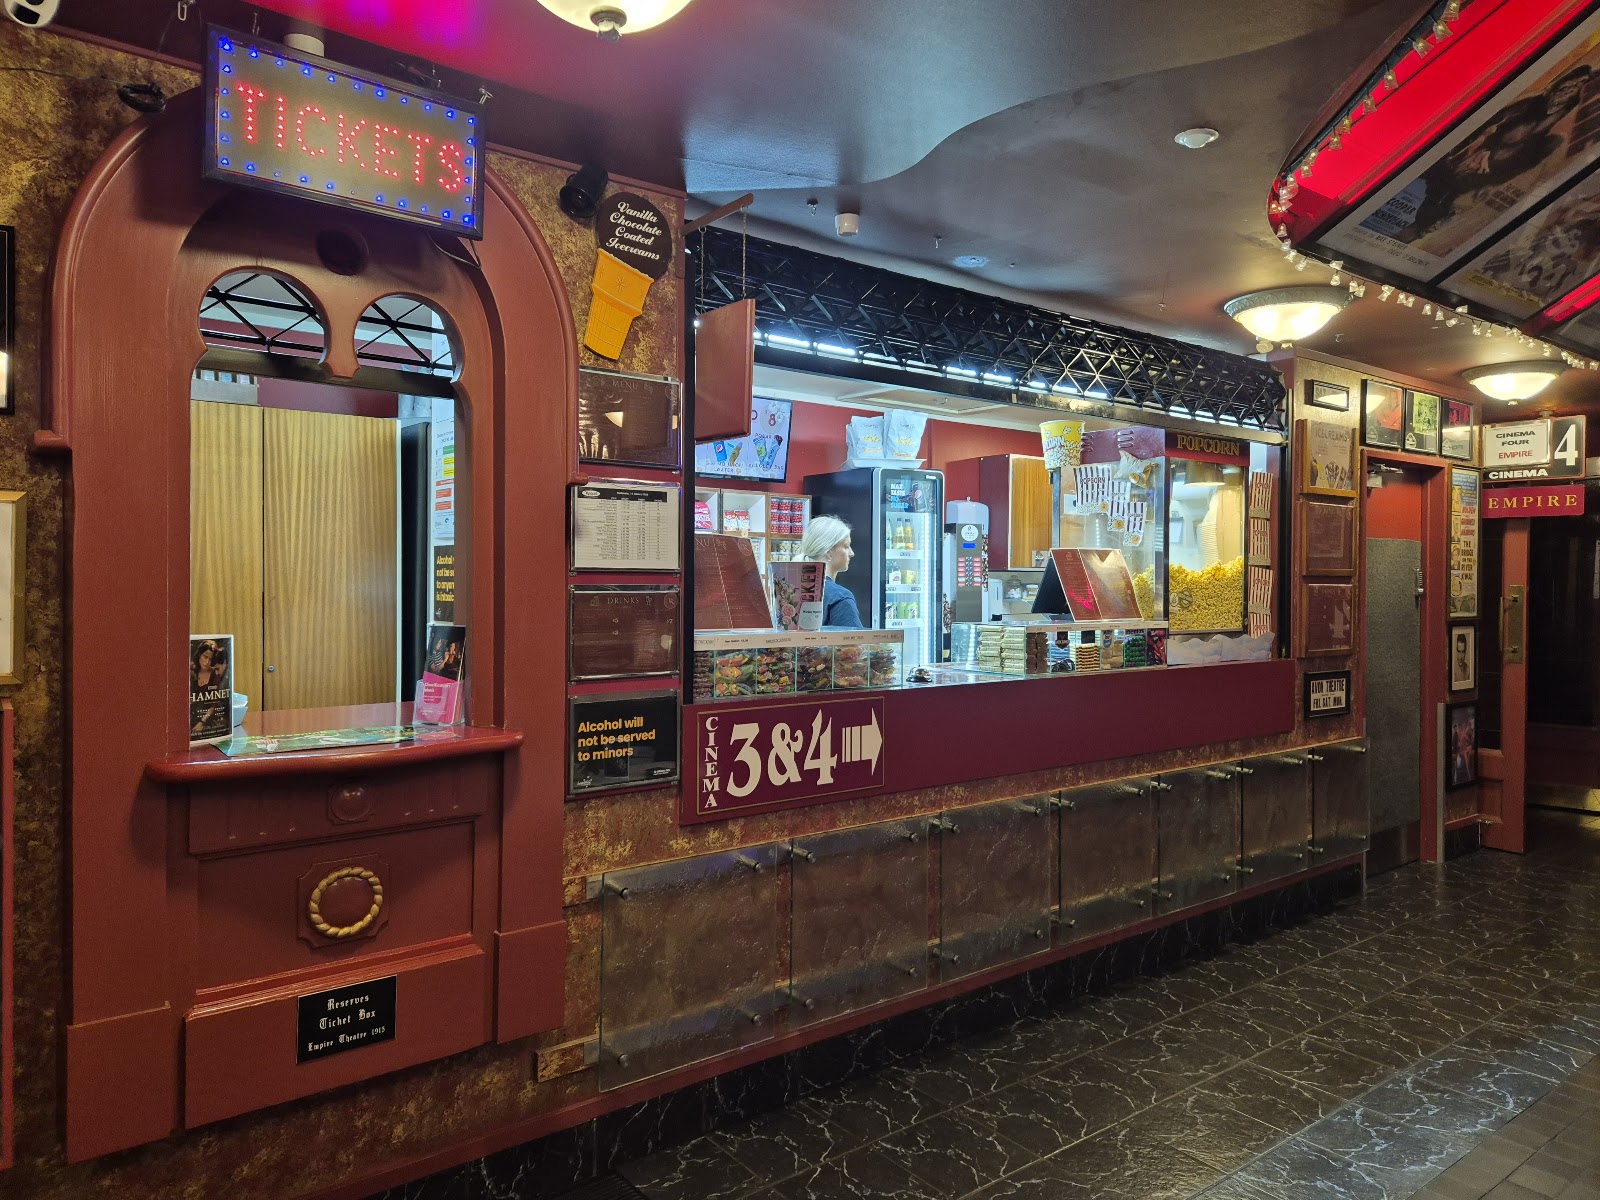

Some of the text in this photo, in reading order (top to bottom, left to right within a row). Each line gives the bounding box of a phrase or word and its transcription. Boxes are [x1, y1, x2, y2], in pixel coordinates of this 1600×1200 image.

[236, 84, 465, 191] TICKETS
[617, 201, 659, 223] Vanilla
[609, 212, 662, 236] Chocolate
[615, 226, 655, 246] Coated
[605, 237, 660, 260] Icecreams
[612, 379, 638, 390] MENU
[1495, 430, 1536, 439] CINEMA
[1501, 439, 1530, 447] FOUR
[1177, 434, 1240, 456] POPCORN
[1498, 450, 1533, 459] EMPIRE
[1554, 424, 1579, 466] 4
[1488, 468, 1549, 479] CINEMA
[1488, 494, 1578, 509] EMPIRE
[578, 716, 644, 733] Alcohol will
[578, 729, 656, 748] not be served
[577, 747, 634, 761] to minors
[702, 716, 721, 808] CINEMA
[726, 708, 838, 798] 3&4
[327, 995, 370, 1011] Reserves
[319, 1008, 376, 1030] Ticket Box
[308, 1025, 386, 1052] Empire Theatre 1915
